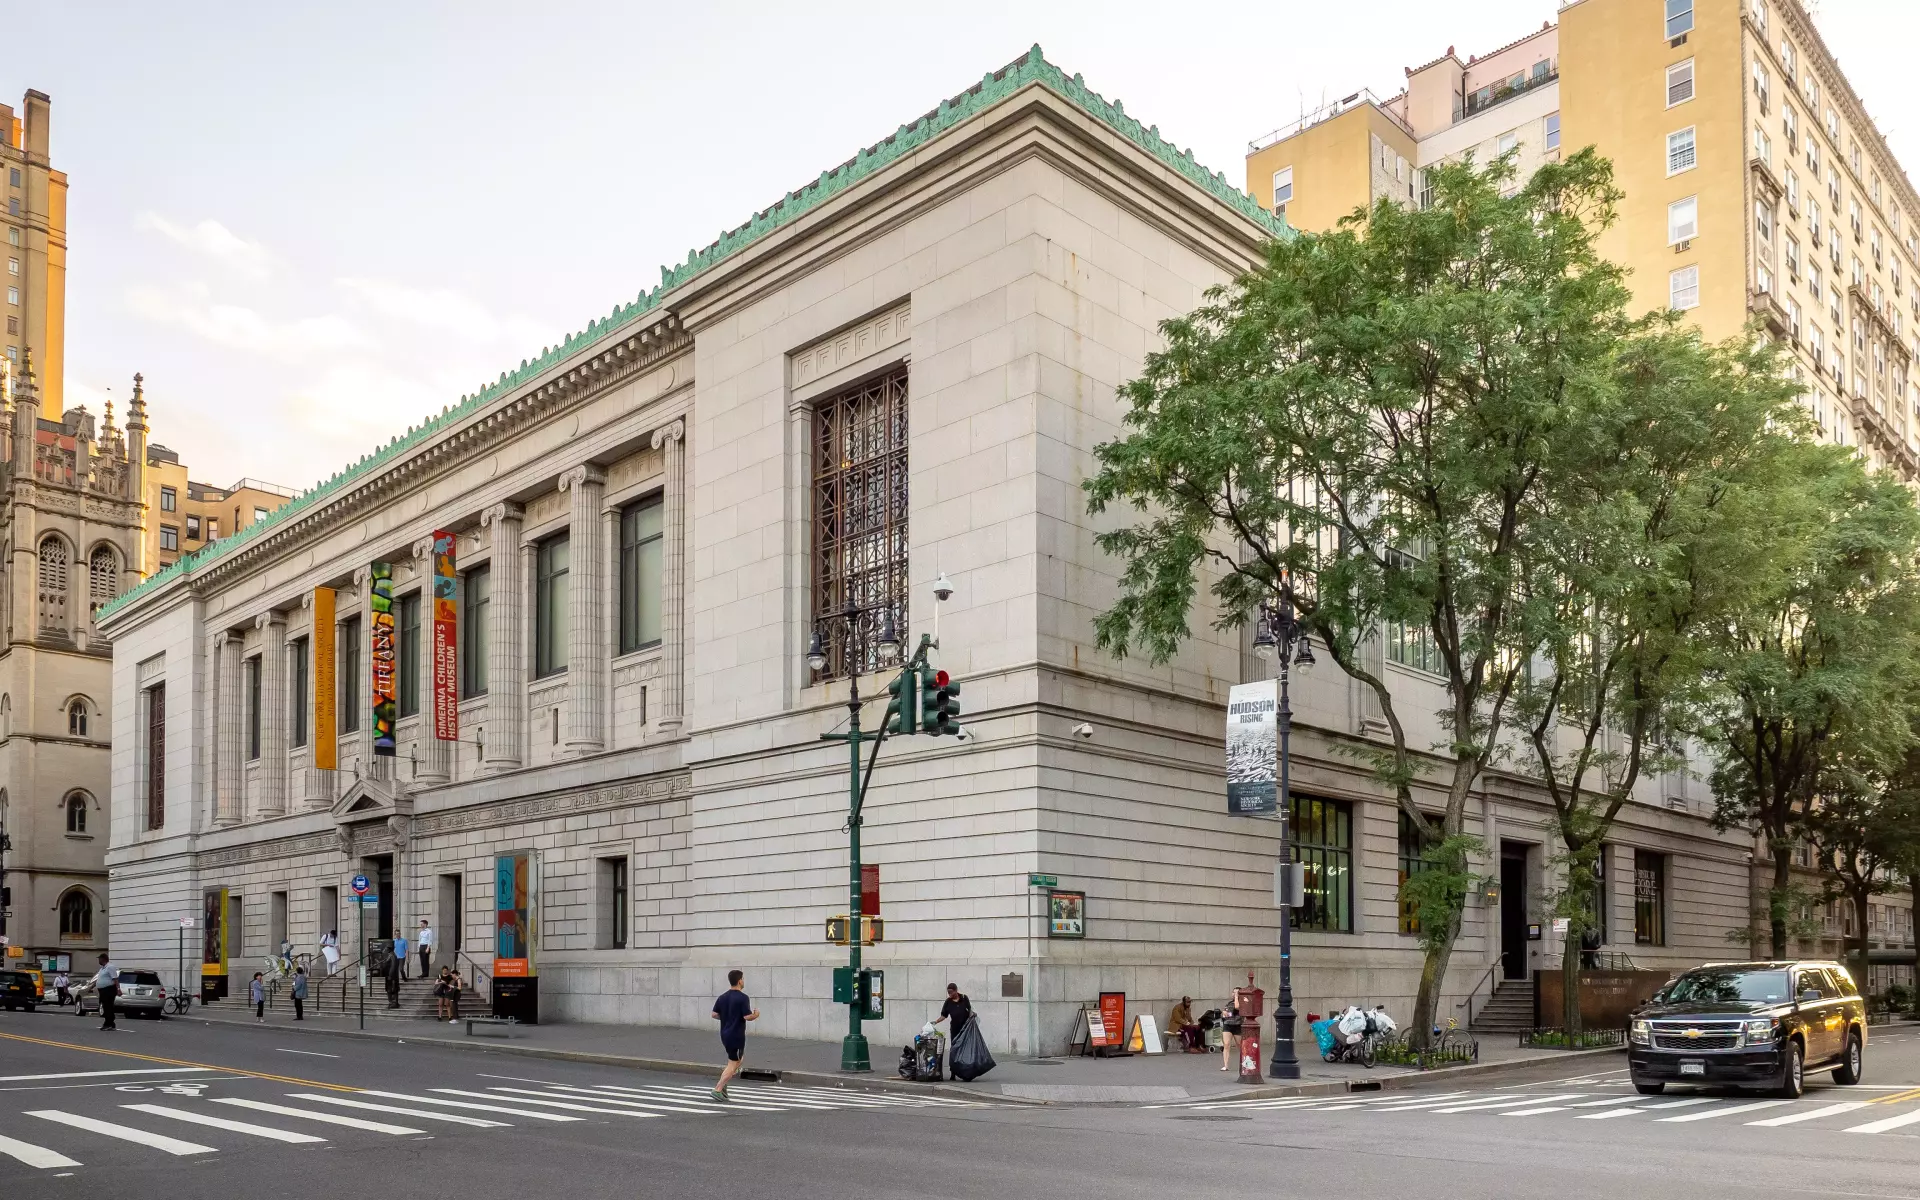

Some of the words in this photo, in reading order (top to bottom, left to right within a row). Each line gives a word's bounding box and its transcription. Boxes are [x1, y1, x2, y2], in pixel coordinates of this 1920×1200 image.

[377, 623, 391, 696] TIFFANY
[437, 624, 446, 684] CHILDREN'S
[446, 646, 455, 692] MUSEUM
[438, 688, 447, 738] DIMENNA
[447, 697, 456, 739] HISTORY
[1230, 699, 1274, 715] HUDSON
[1240, 713, 1263, 724] RISING
[1635, 878, 1656, 896] TORE
